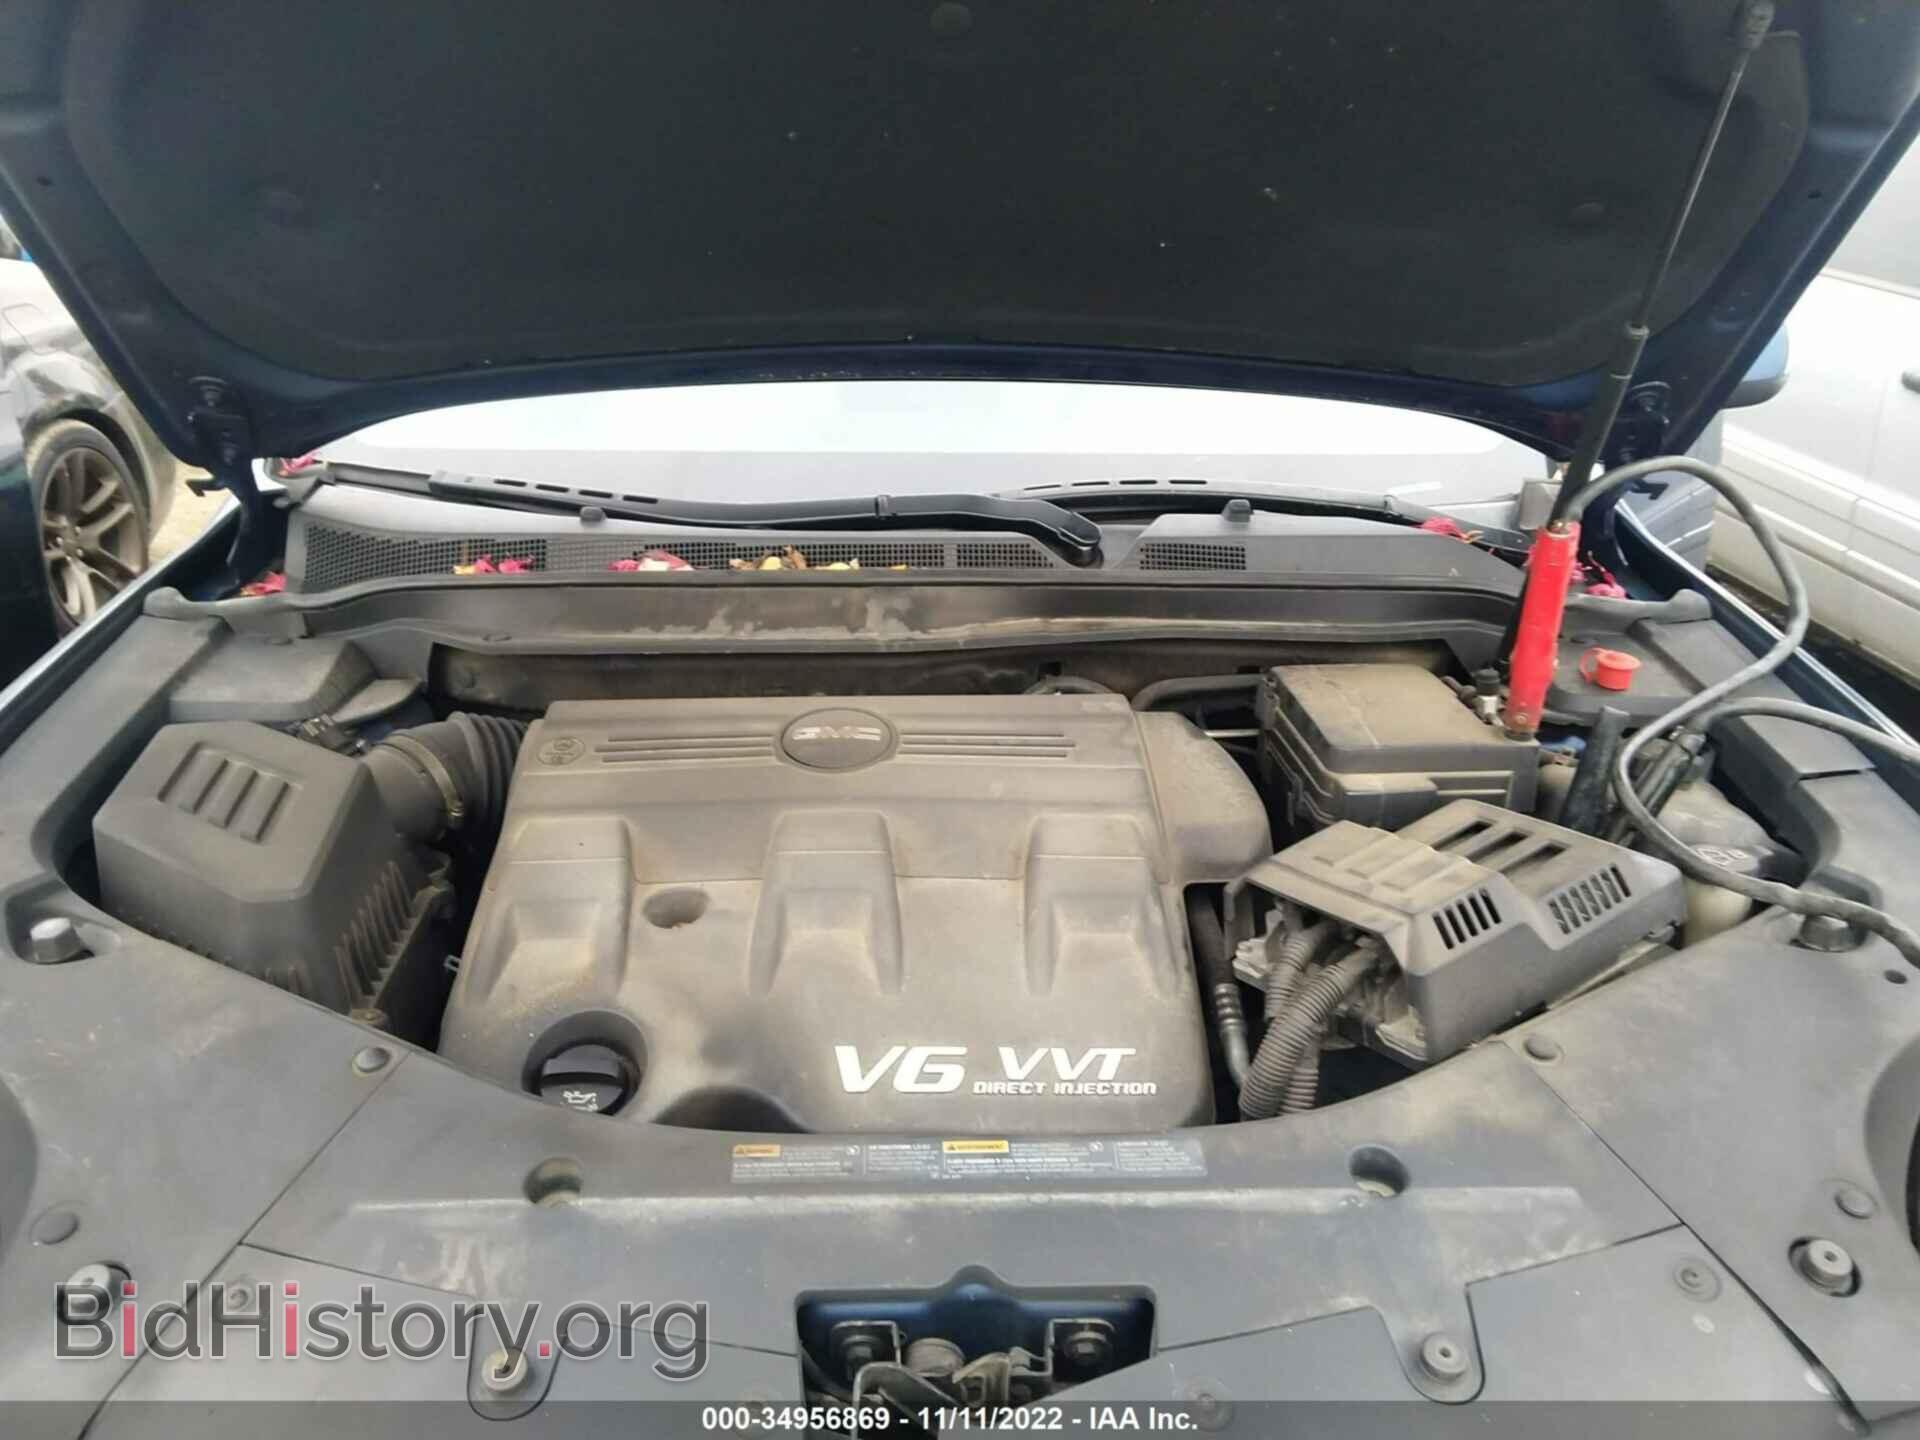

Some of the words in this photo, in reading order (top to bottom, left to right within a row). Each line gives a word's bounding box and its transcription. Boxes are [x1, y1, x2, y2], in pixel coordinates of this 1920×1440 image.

[834, 1045, 968, 1093] V6
[997, 1046, 1137, 1081] VVT
[972, 1081, 1047, 1096] DIRECT
[1054, 1081, 1157, 1096] INJECTION
